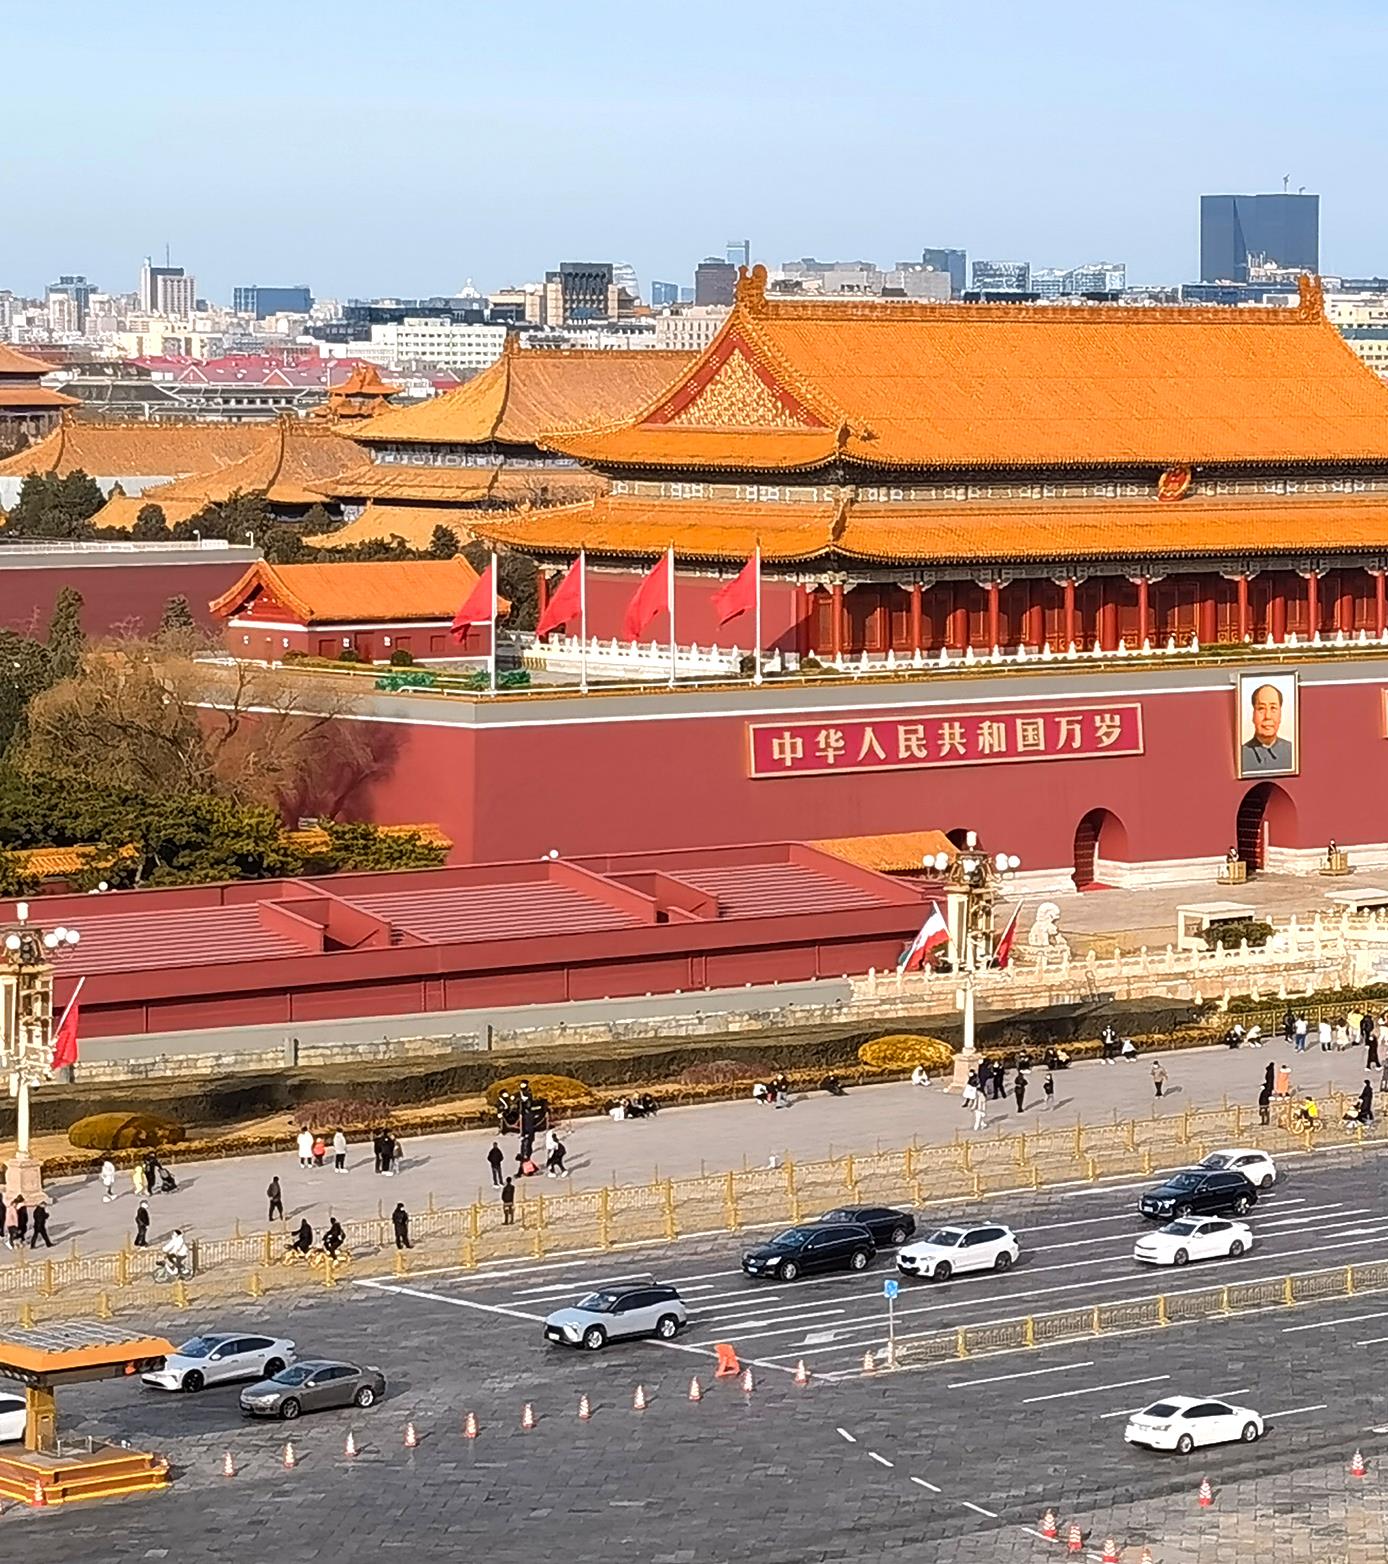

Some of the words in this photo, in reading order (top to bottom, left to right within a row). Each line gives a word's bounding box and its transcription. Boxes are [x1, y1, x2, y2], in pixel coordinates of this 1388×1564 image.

[771, 714, 1122, 767] 中华人民共和国万岁
